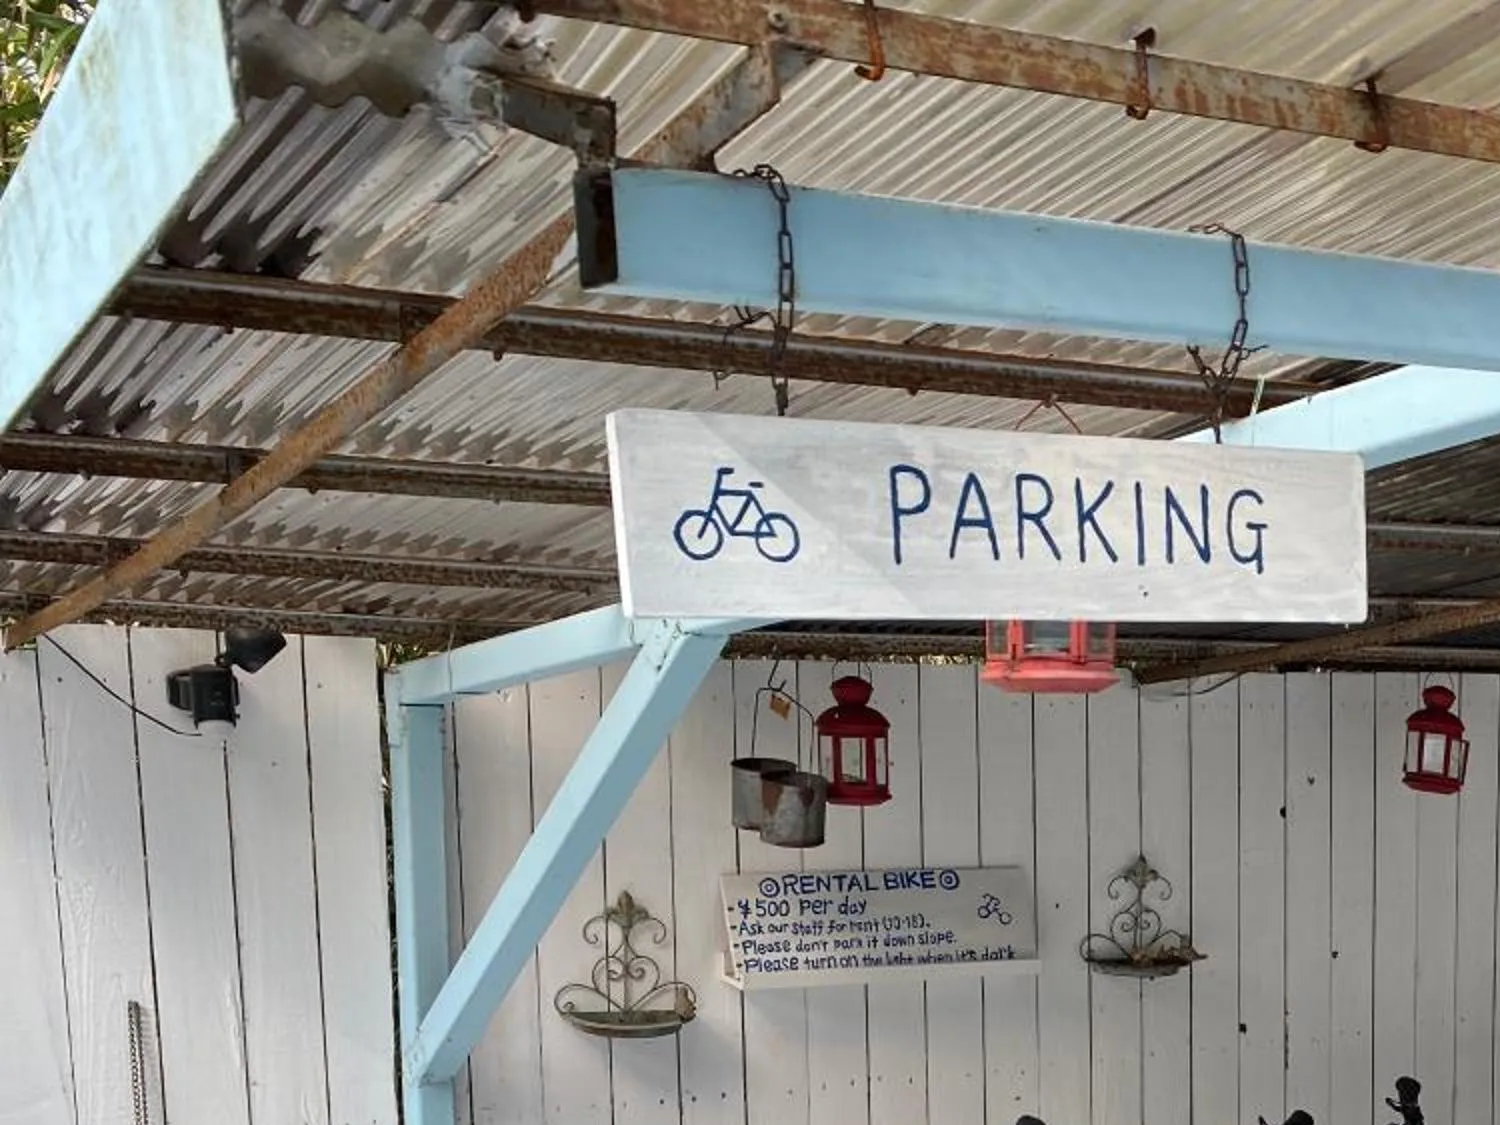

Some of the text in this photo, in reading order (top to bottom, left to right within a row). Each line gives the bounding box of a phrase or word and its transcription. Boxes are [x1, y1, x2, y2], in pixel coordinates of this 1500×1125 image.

[890, 464, 1268, 575] PARKING
[782, 870, 936, 895] RENTAL BIKE
[838, 896, 867, 915] day
[739, 920, 764, 936] Ask
[767, 923, 789, 934] our
[828, 919, 847, 935] for
[849, 918, 879, 933] rent
[742, 938, 792, 955] Please
[867, 936, 878, 949] it
[884, 931, 915, 947] down
[744, 957, 799, 974] Please
[803, 954, 838, 970] turn
[841, 954, 859, 969] on
[982, 945, 1015, 961] dark
